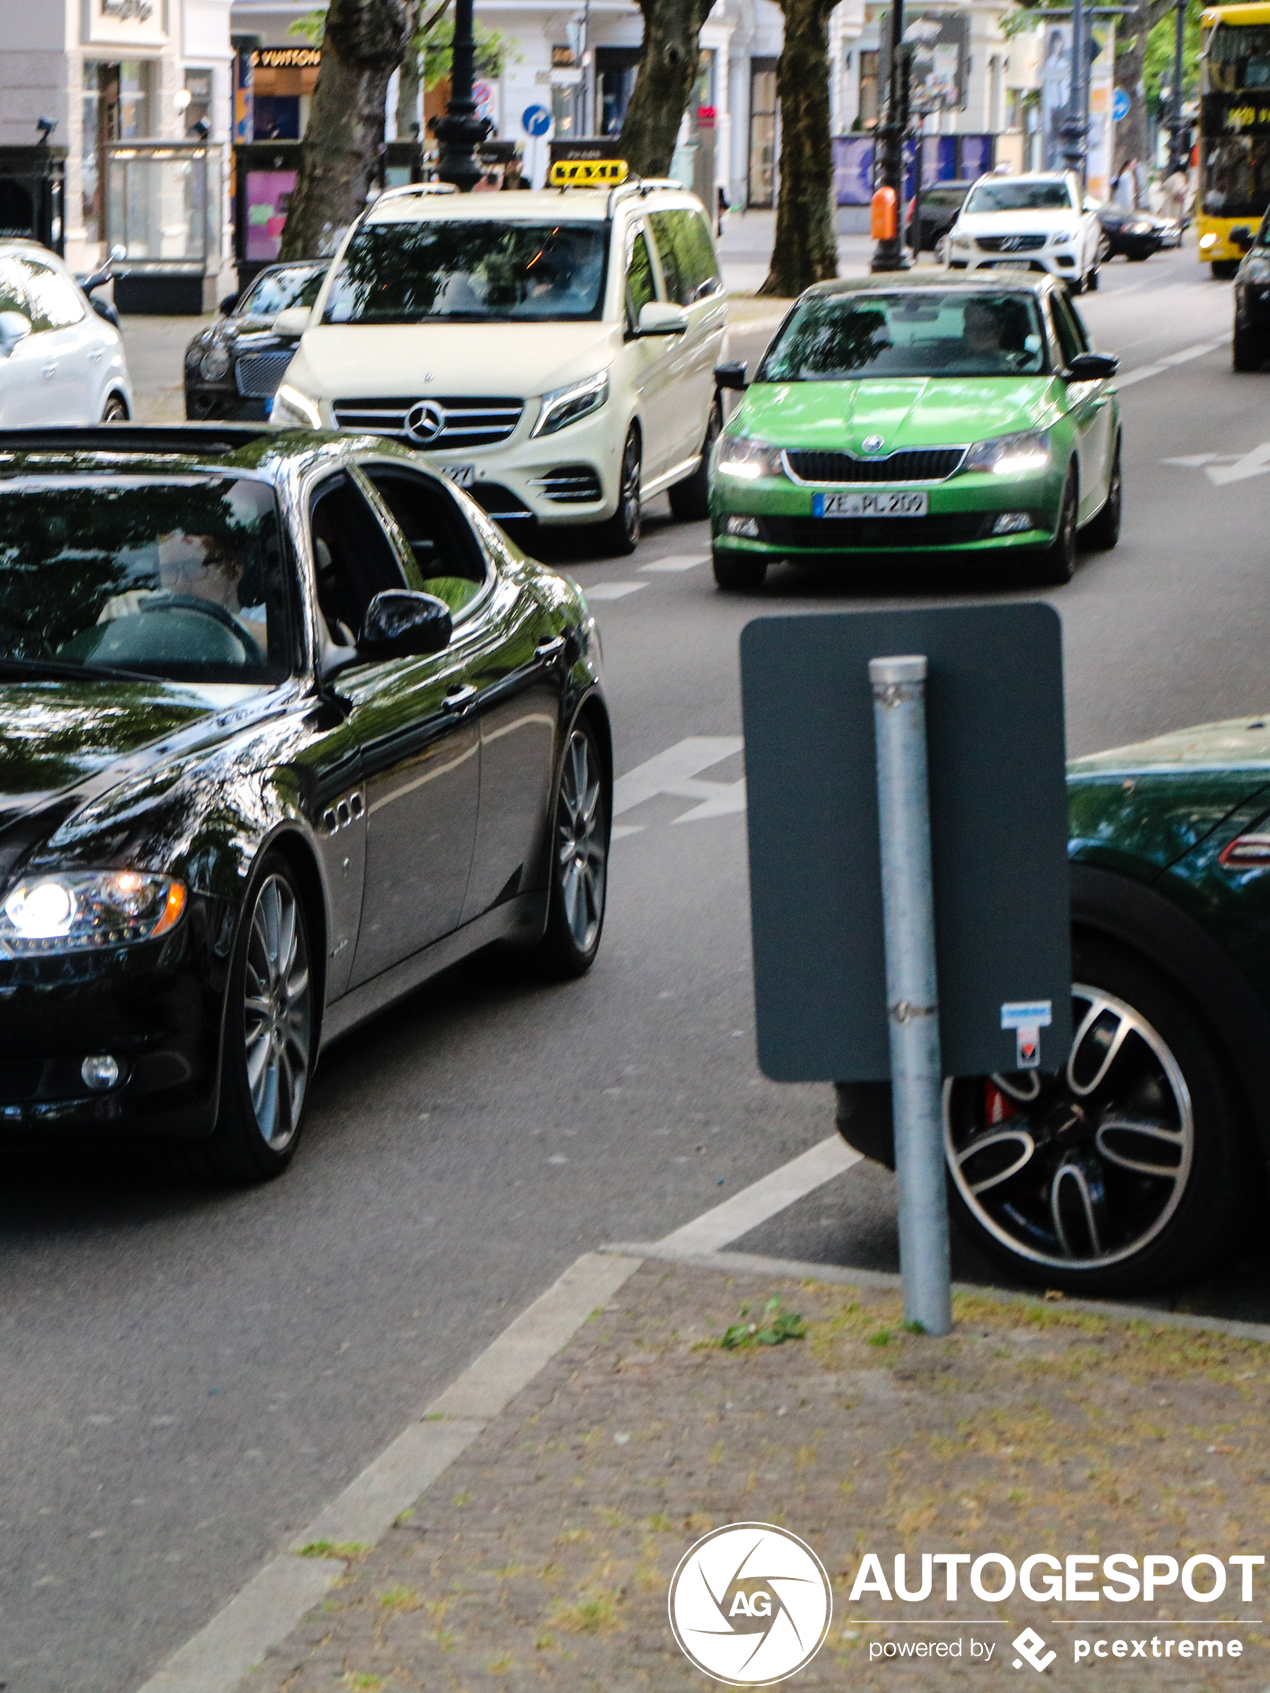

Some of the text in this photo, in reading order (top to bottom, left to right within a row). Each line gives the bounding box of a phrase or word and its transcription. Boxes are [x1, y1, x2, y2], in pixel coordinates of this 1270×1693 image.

[261, 49, 322, 66] VUITTON
[555, 165, 619, 178] TAXI
[825, 492, 923, 514] ZE PL 209
